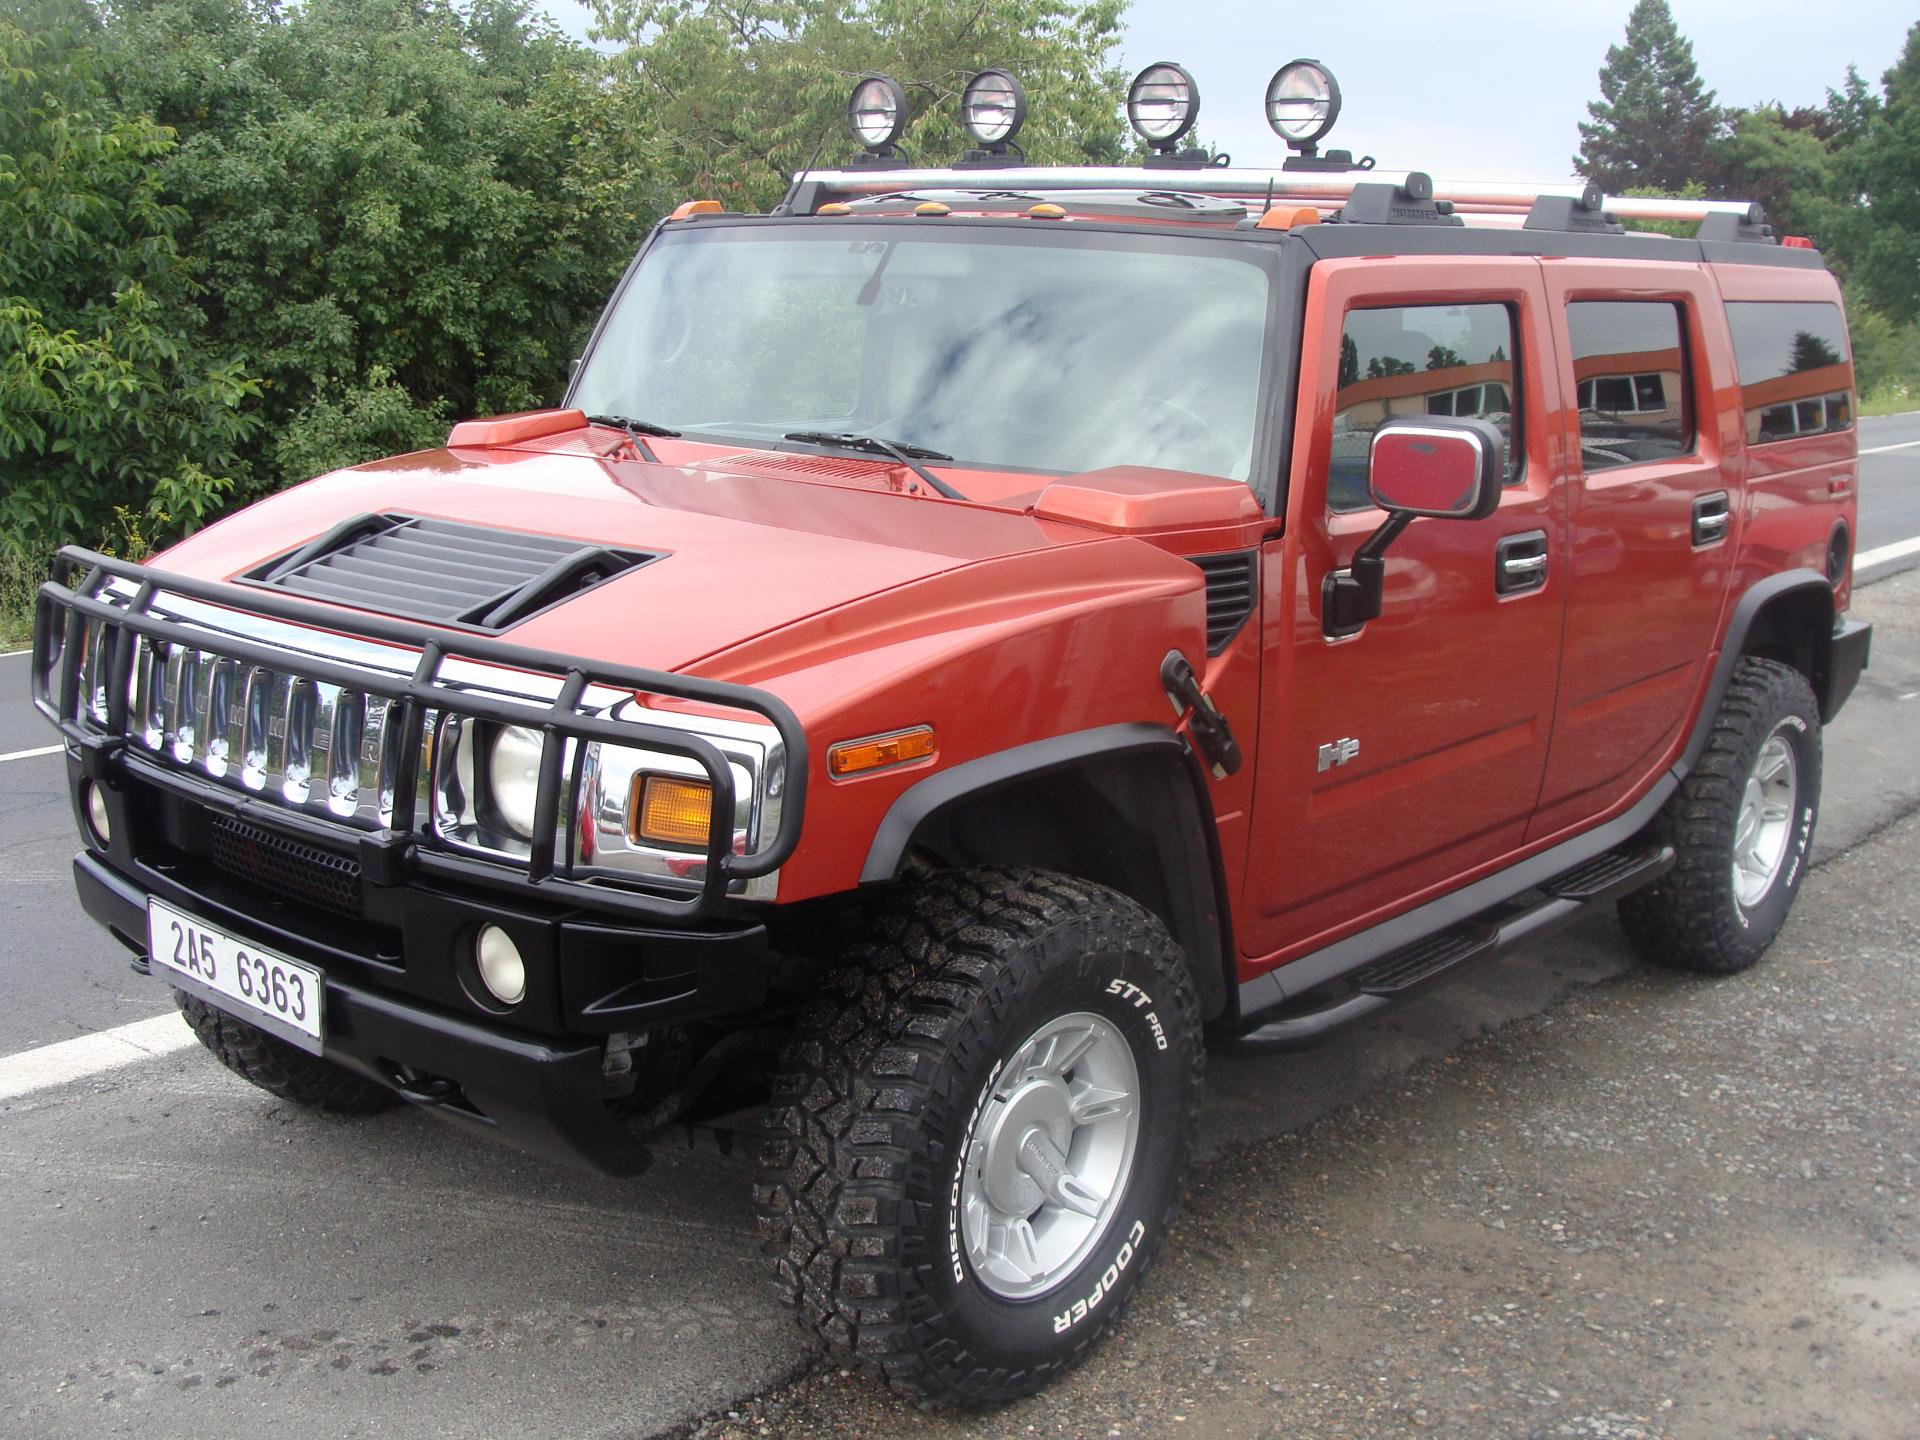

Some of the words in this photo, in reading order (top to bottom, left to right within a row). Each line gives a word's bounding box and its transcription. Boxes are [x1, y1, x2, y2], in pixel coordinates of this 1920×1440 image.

[1317, 737, 1360, 774] H2
[1799, 807, 1813, 854] STT
[171, 920, 217, 980] 2A5
[237, 951, 306, 1021] 6363
[949, 1058, 1002, 1284] DISCOVERER
[1105, 979, 1152, 1008] STT
[1145, 1012, 1168, 1051] PRO
[1054, 1220, 1145, 1334] COOPER
